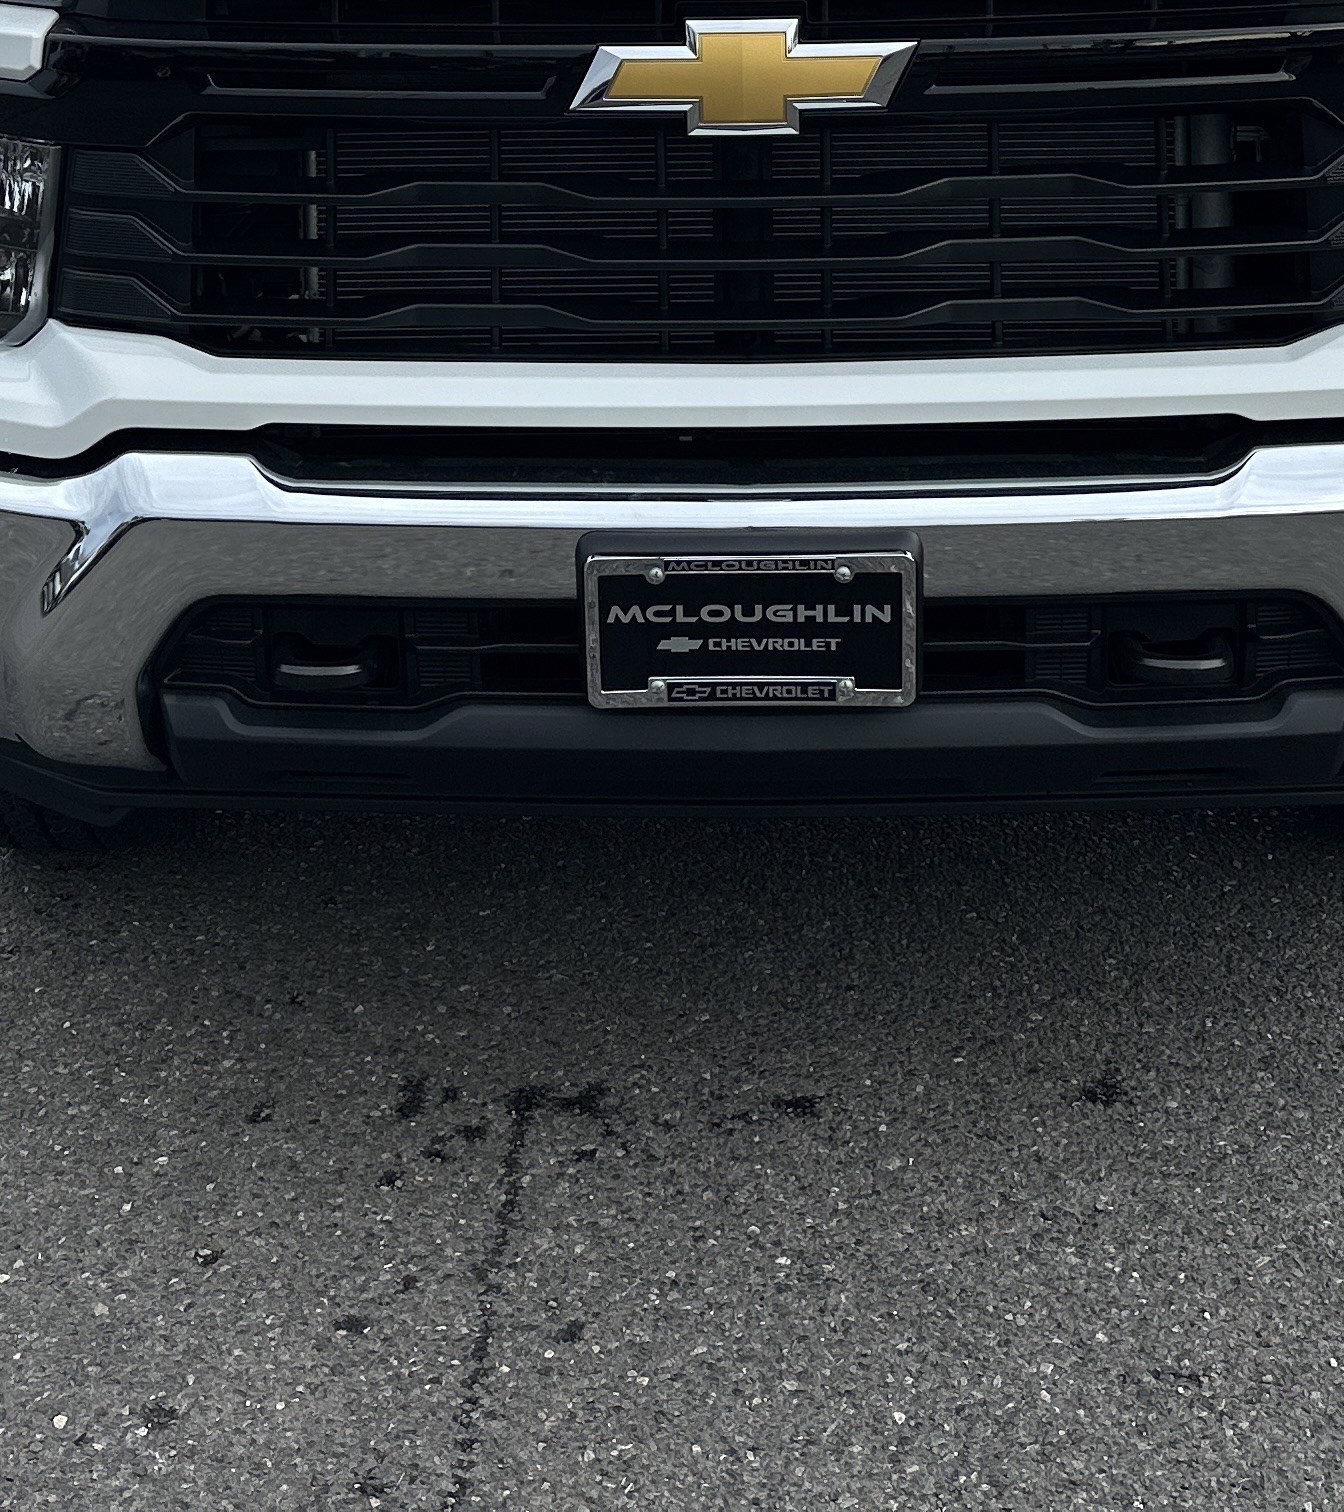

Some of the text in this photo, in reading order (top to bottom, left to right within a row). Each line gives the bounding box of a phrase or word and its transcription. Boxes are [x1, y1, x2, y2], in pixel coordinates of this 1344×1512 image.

[667, 559, 834, 571] MCLOUGHLIN
[607, 604, 892, 624] MCLOUGHLIN
[708, 638, 842, 651] CHEVROLET
[715, 685, 834, 698] CHEVROLET
